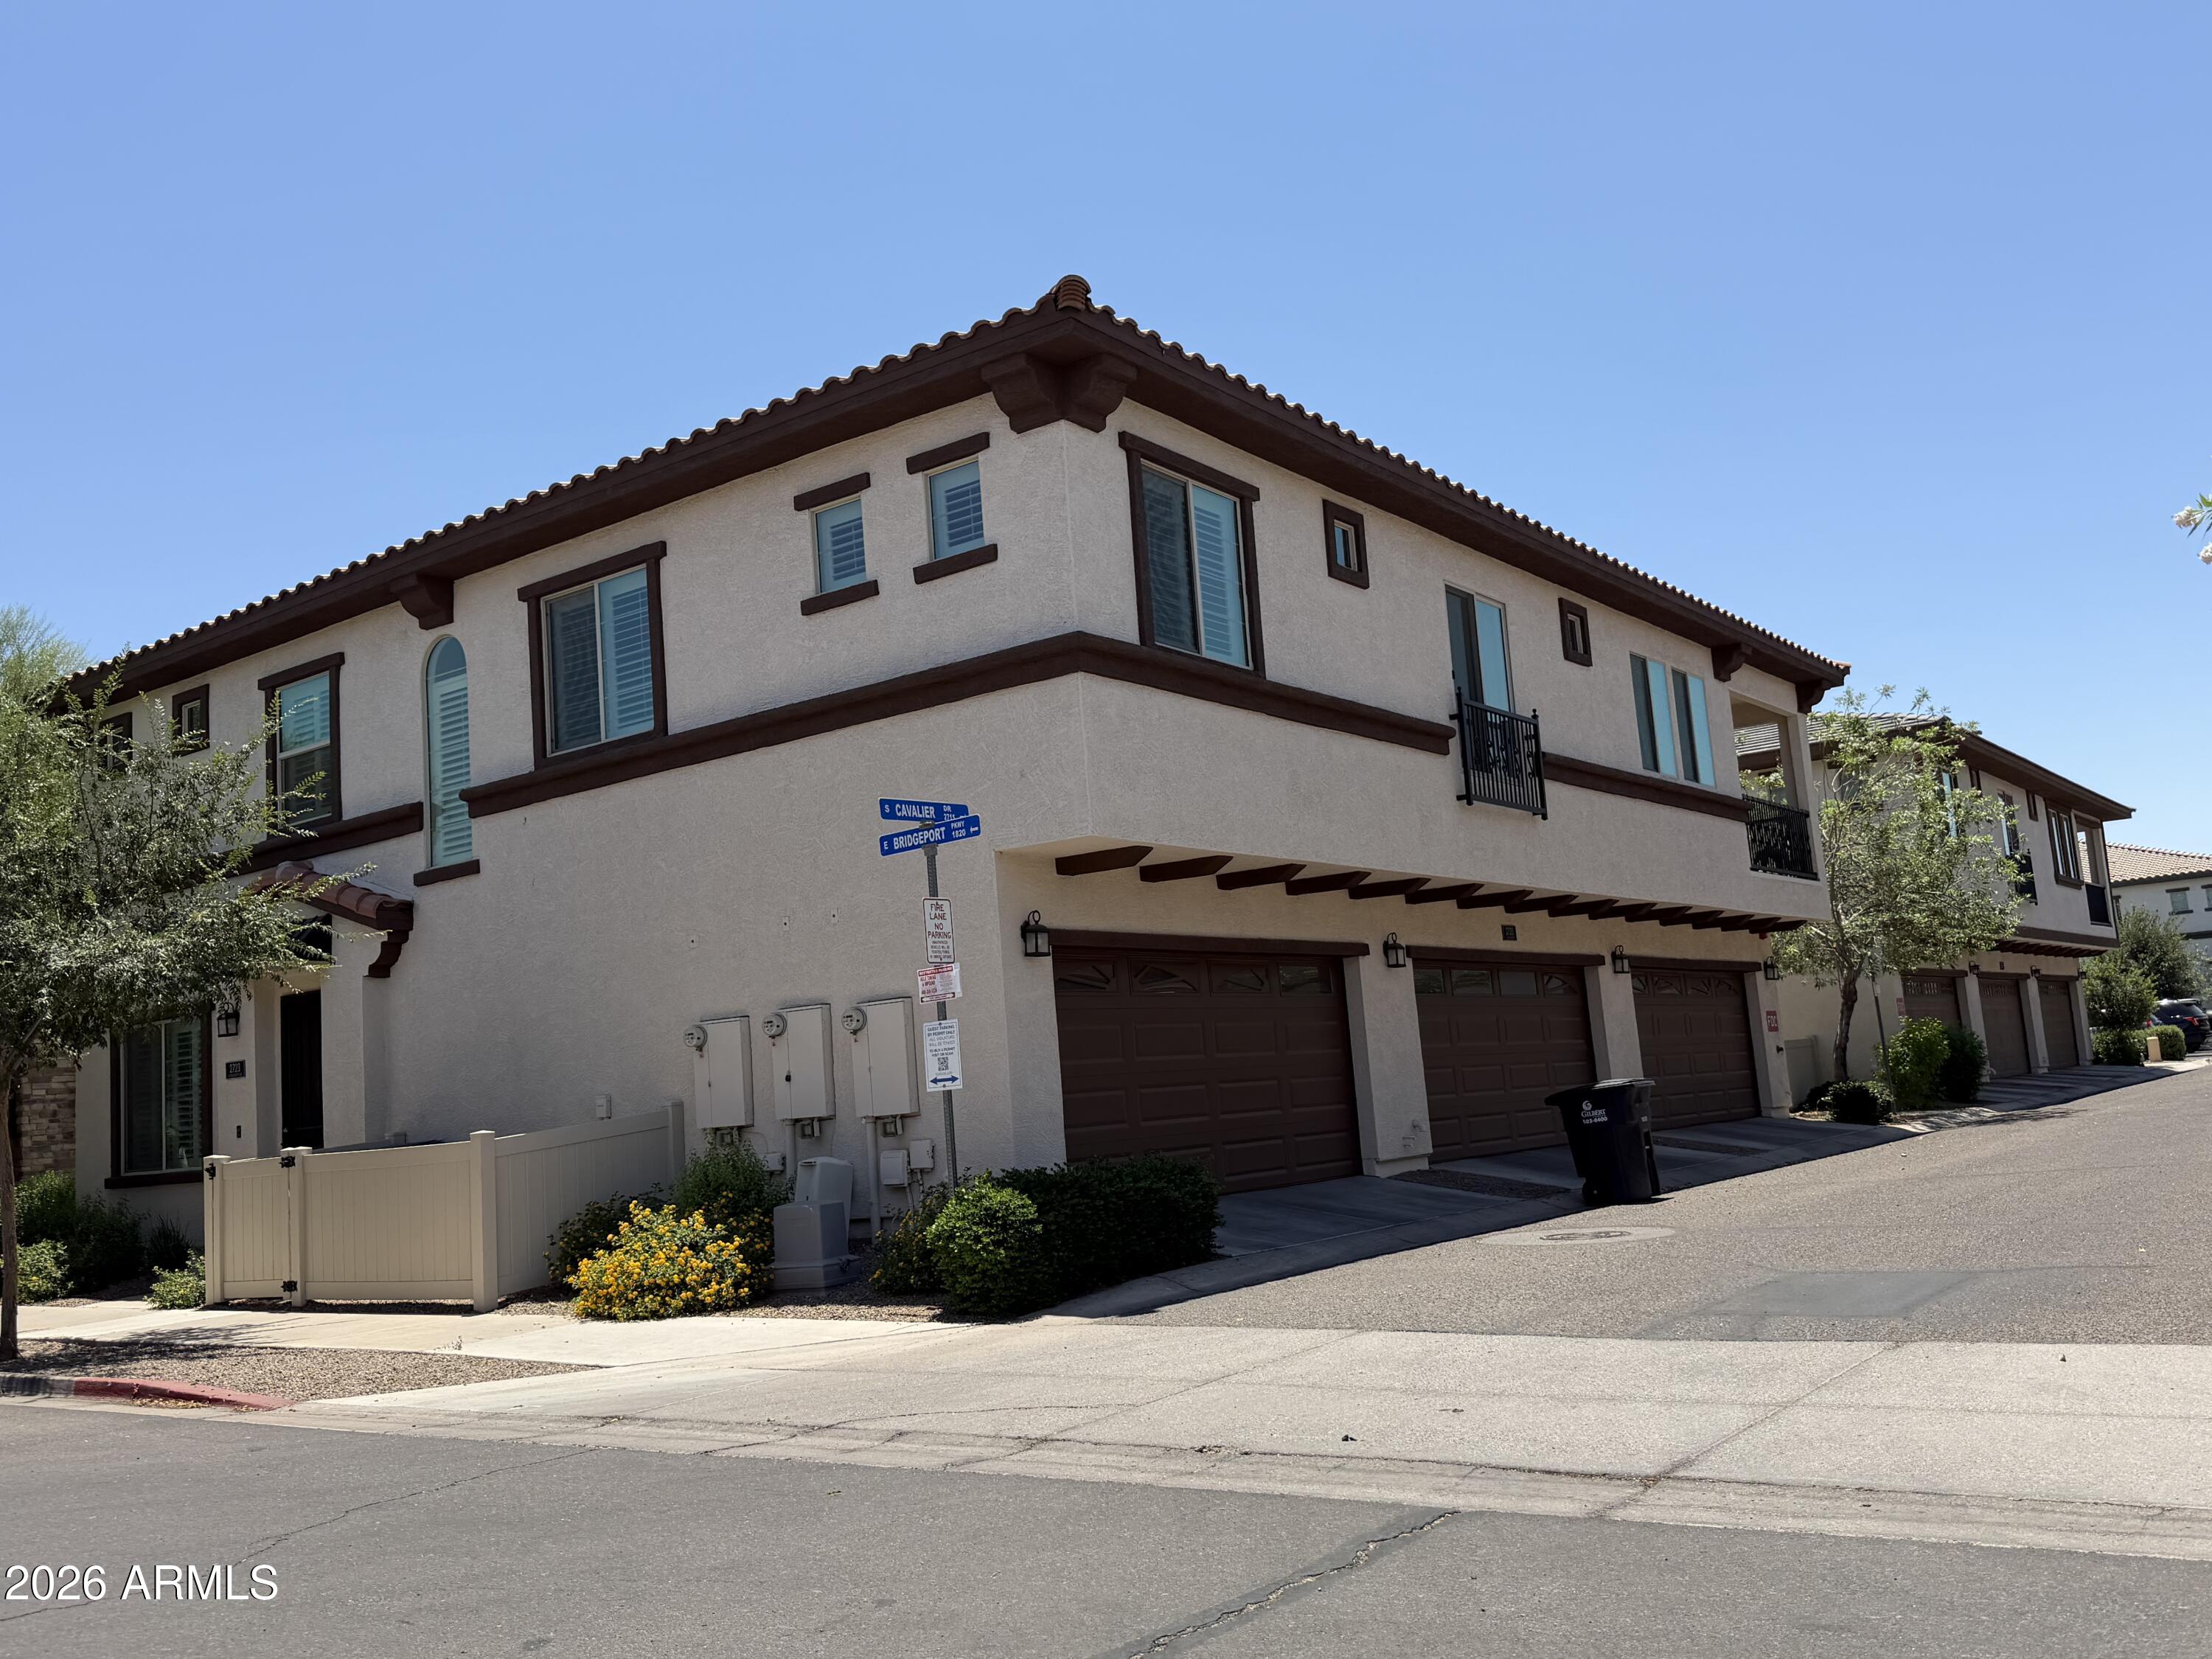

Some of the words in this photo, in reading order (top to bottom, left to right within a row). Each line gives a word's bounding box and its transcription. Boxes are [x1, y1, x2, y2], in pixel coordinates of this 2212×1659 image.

[885, 805, 890, 813] S
[895, 804, 935, 818] CAVALIER
[893, 827, 945, 850] BRIDGEPORT
[951, 821, 964, 829] PKWY
[952, 829, 966, 838] 1820
[1581, 1109, 1606, 1118] GILBERT
